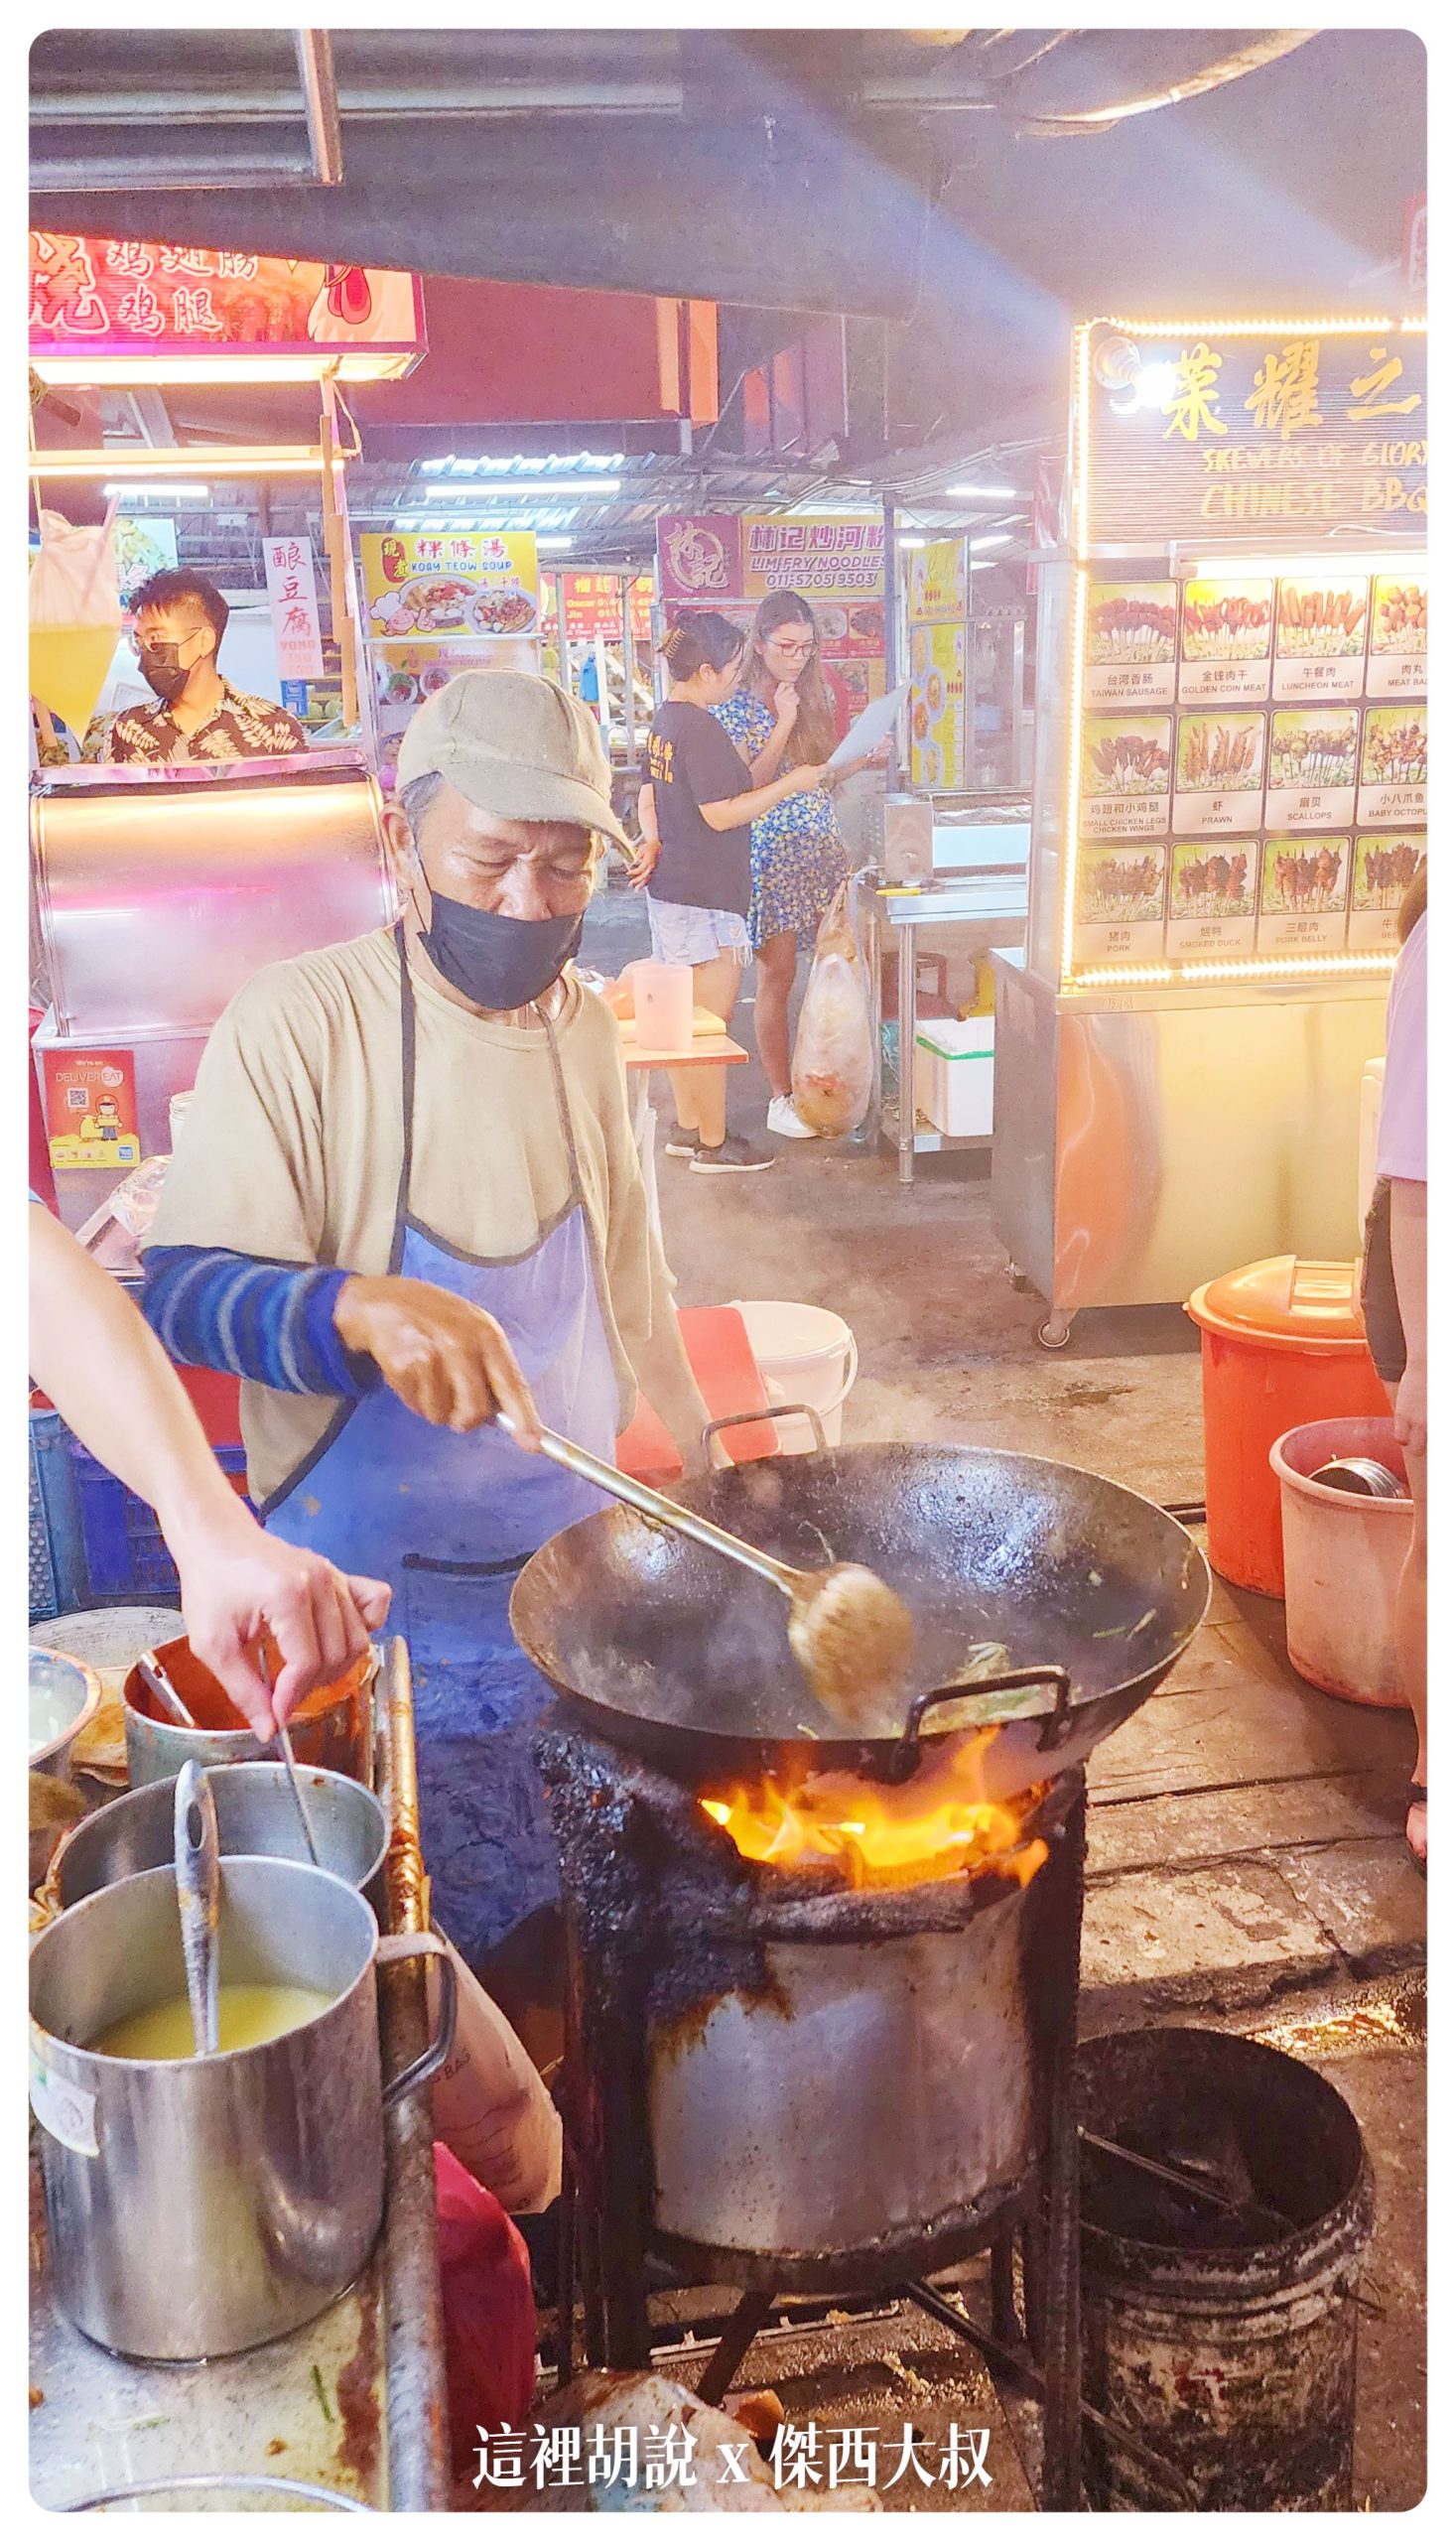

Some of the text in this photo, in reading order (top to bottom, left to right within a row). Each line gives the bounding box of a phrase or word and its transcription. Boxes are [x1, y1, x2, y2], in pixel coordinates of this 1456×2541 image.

[117, 283, 223, 336] 鸡腿
[1362, 476, 1427, 516] BBQ
[749, 523, 884, 552] 林记炒河粉
[412, 560, 512, 572] KOAY TEOW SOUP
[751, 556, 781, 571] LIM
[782, 556, 814, 572] FRY
[836, 572, 874, 587] 9503
[272, 542, 314, 637] 酿豆腐
[1302, 667, 1336, 679] 午餐肉
[1401, 664, 1423, 675] 肉丸
[1108, 673, 1153, 686] 台湾香肠
[1202, 670, 1249, 682] 金钱肉干
[1182, 683, 1267, 695] GOLDEN COIN MEAT
[1281, 680, 1354, 691] LUNCHEON MEAT
[1092, 687, 1168, 698] TAIWAN SAUSAGE
[1380, 792, 1424, 805] 小八爪鱼
[1212, 801, 1224, 812] 虾
[1202, 816, 1233, 825] PRAWN
[1287, 812, 1332, 821] SCALLOPS
[1285, 921, 1319, 933] 三层肉
[1109, 931, 1130, 942] 猪肉
[1276, 934, 1327, 945] PORK BELLY
[1179, 938, 1241, 949] SMOKED DUCK
